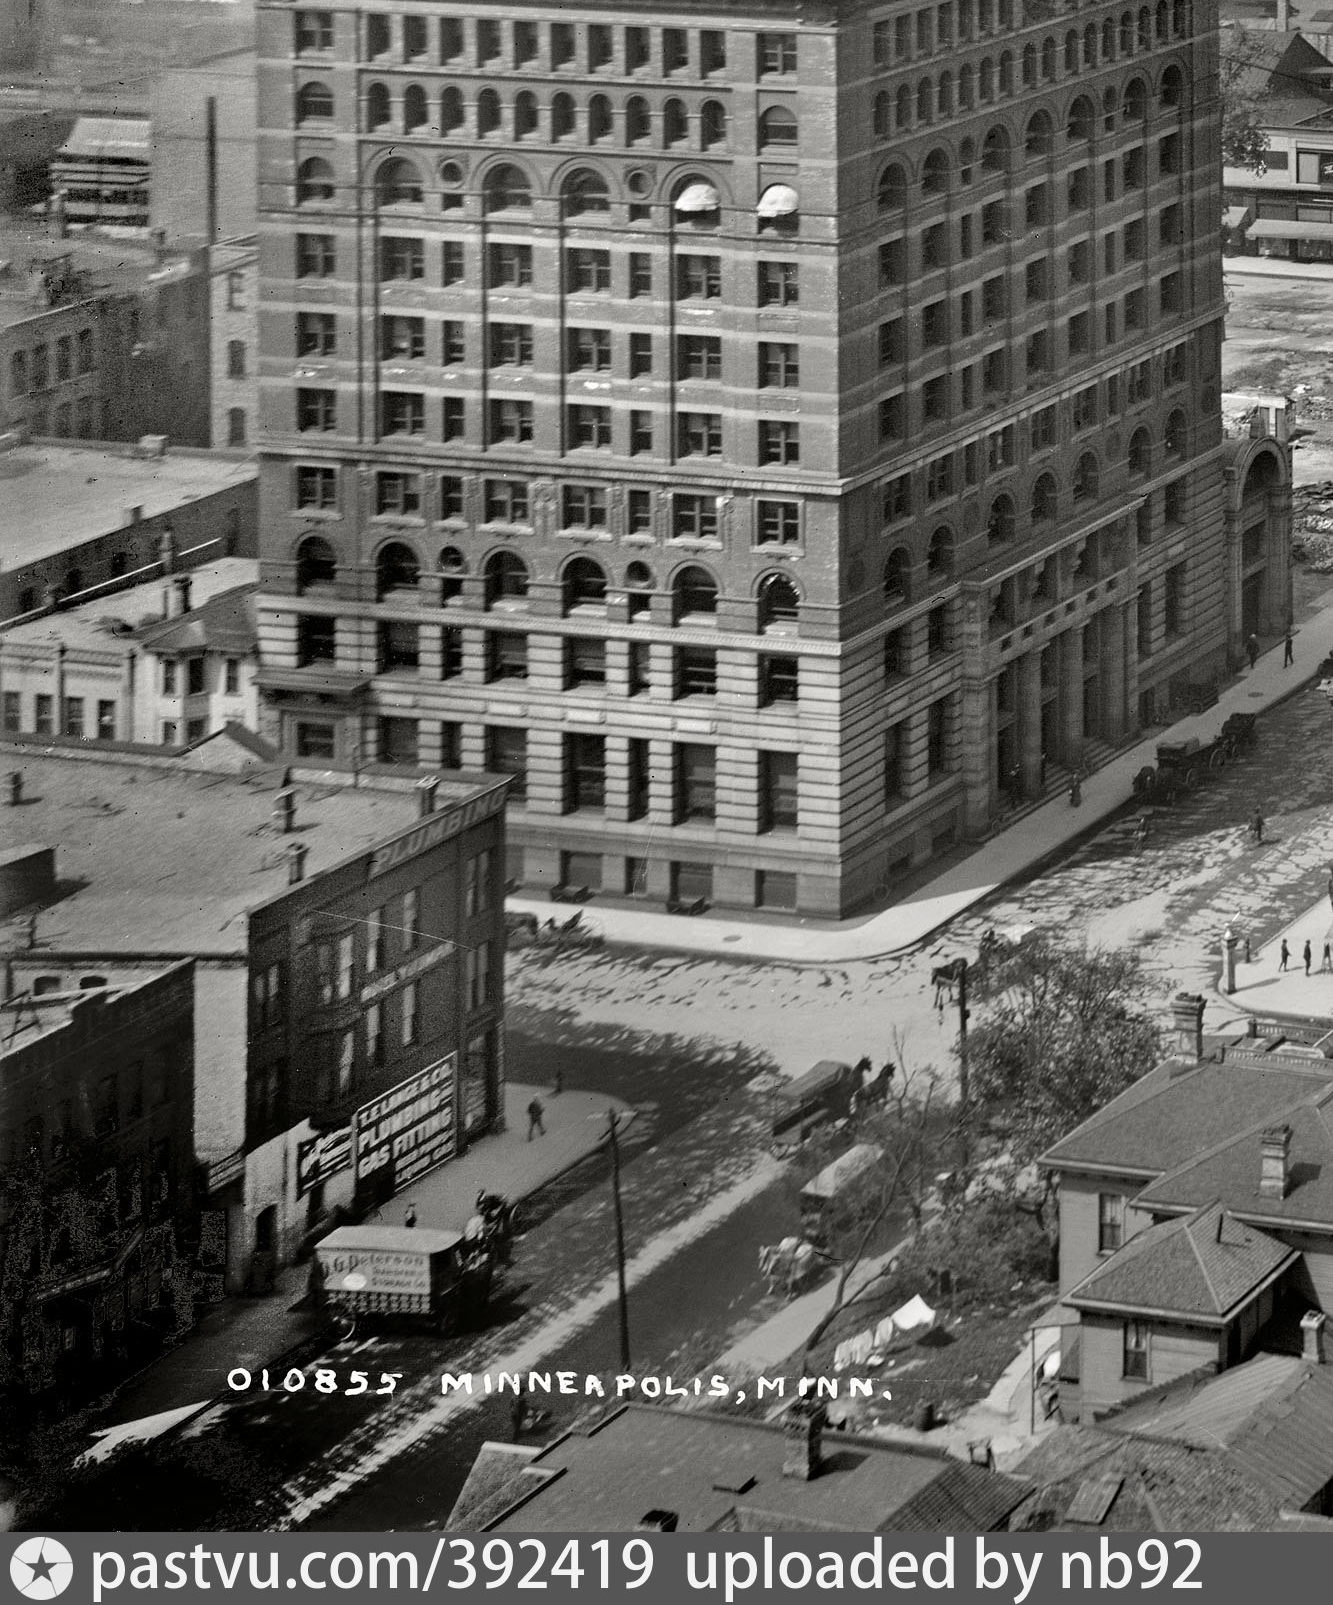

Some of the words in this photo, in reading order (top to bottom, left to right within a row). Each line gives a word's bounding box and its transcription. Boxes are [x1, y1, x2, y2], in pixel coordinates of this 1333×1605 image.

[369, 785, 508, 880] PLUMBING
[358, 1088, 442, 1157] PLUMBING
[358, 1144, 391, 1179] GAS
[392, 1106, 452, 1160] FITTING
